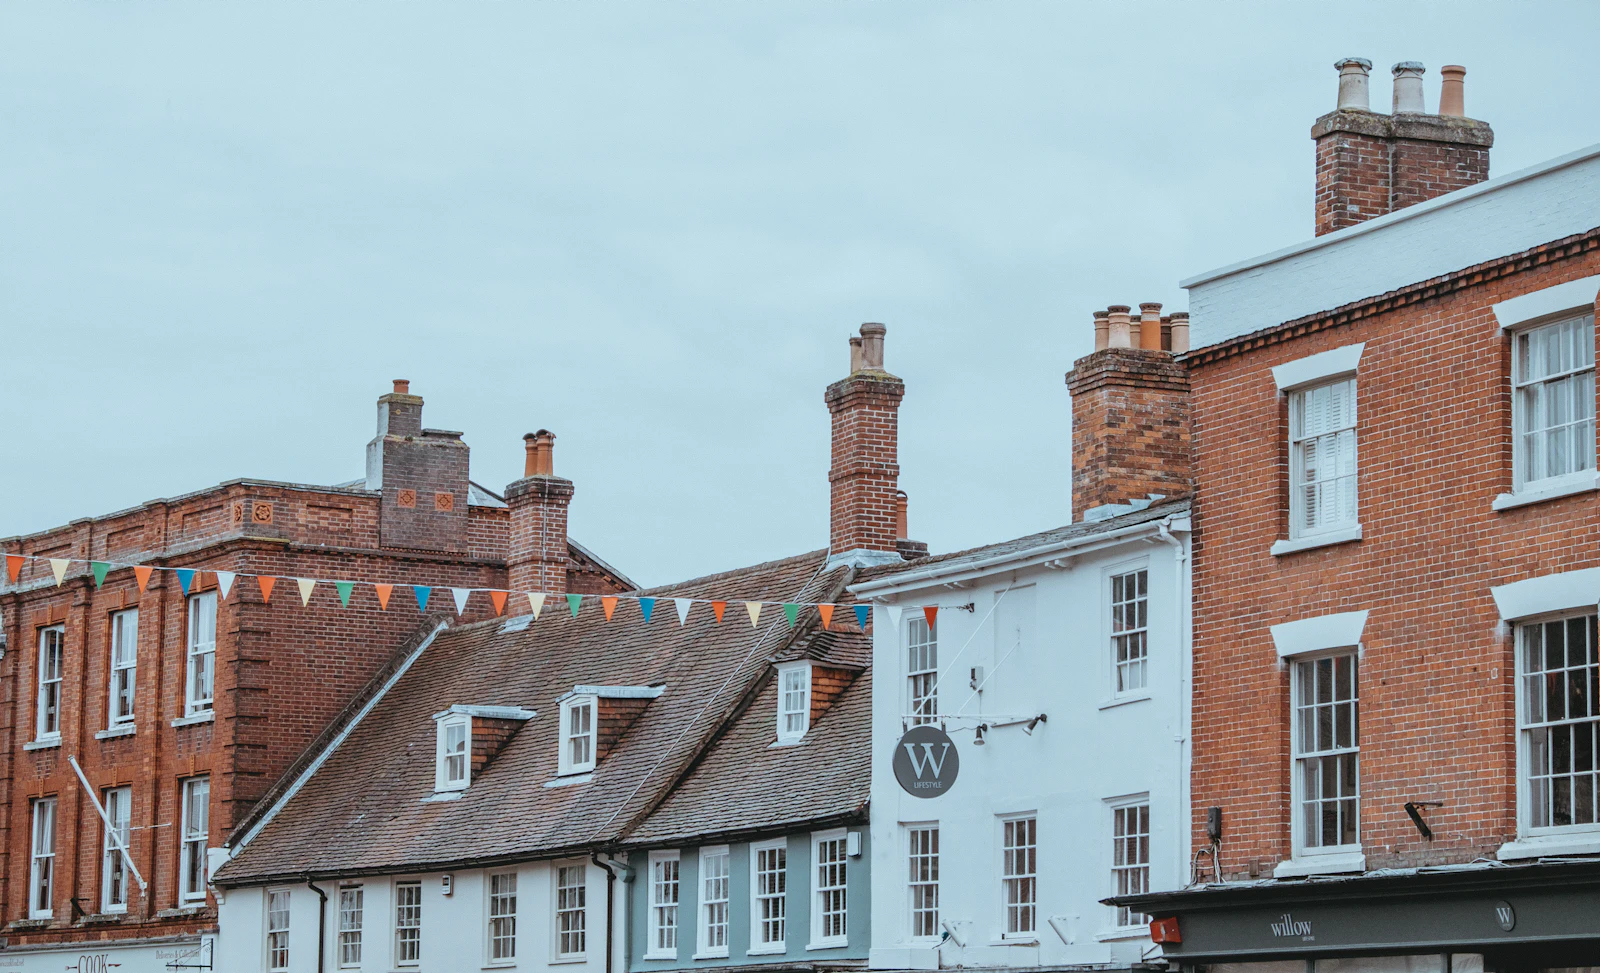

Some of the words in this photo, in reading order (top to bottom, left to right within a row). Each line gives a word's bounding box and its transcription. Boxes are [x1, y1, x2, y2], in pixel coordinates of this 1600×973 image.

[903, 742, 951, 780] W
[913, 781, 942, 789] LIFESTYLE
[1270, 913, 1313, 937] willow
[1496, 907, 1511, 924] W
[78, 954, 109, 973] COOK
